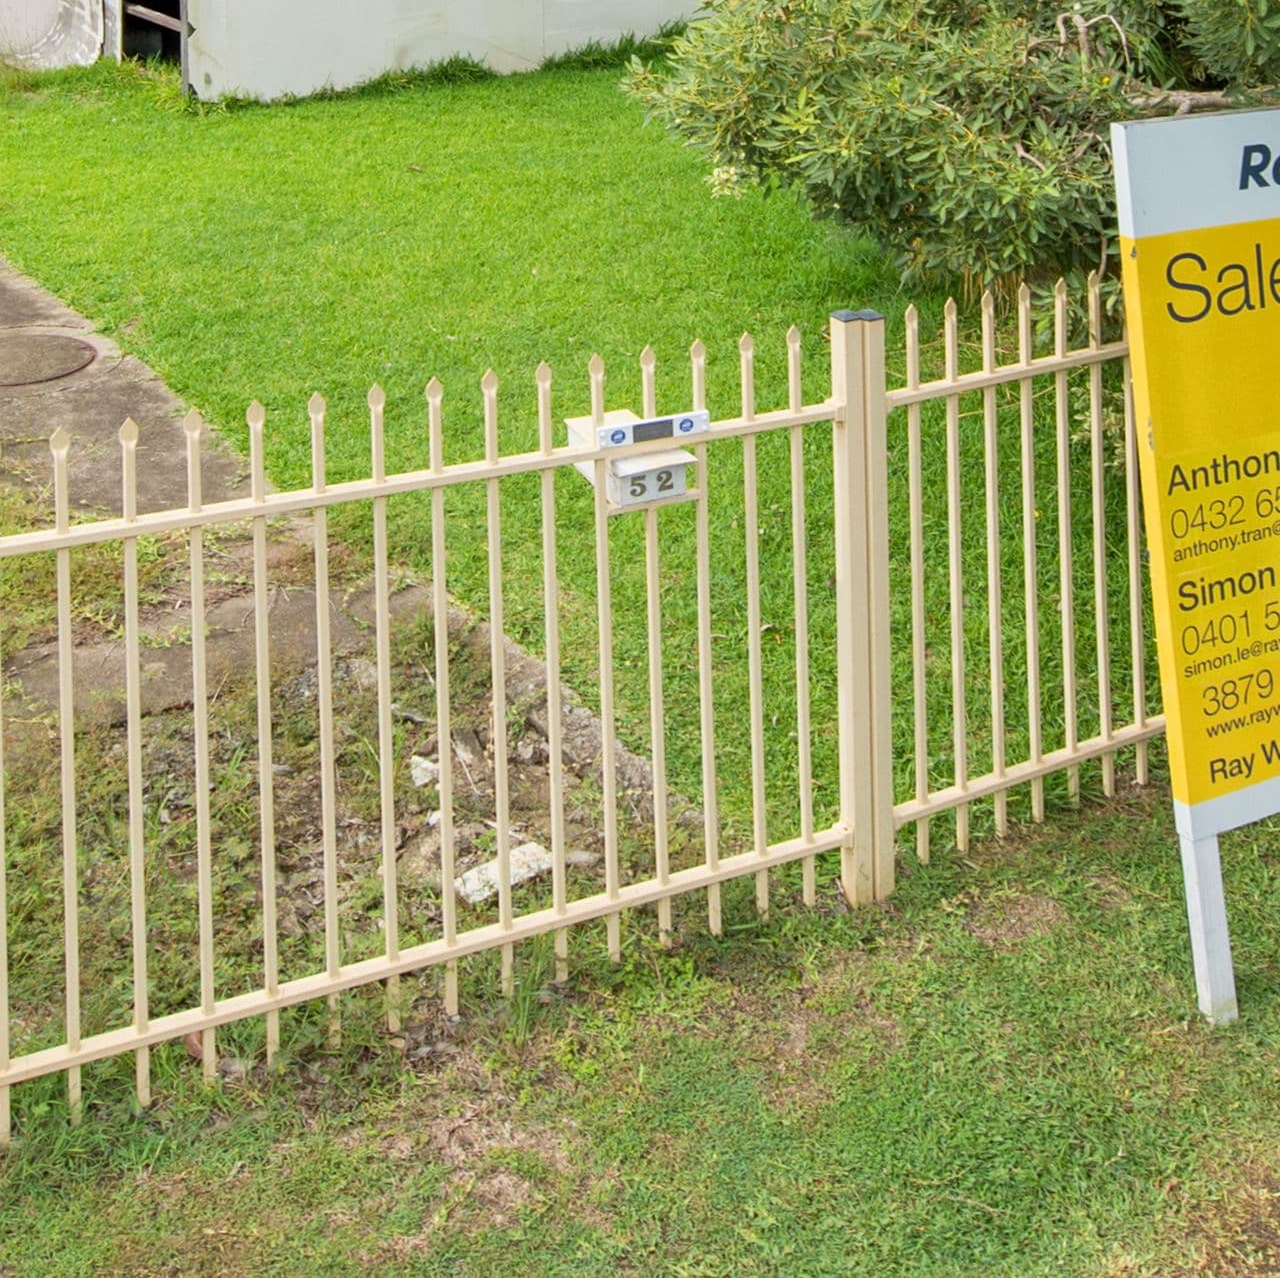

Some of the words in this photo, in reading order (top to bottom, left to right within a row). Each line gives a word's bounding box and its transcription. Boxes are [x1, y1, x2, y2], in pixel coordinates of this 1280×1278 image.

[630, 471, 674, 497] 52
[1170, 495, 1245, 540] 0432
[1177, 566, 1276, 612] Simon
[1181, 610, 1252, 656] 0401
[1202, 669, 1275, 717] 3879
[1209, 751, 1256, 784] Ray
